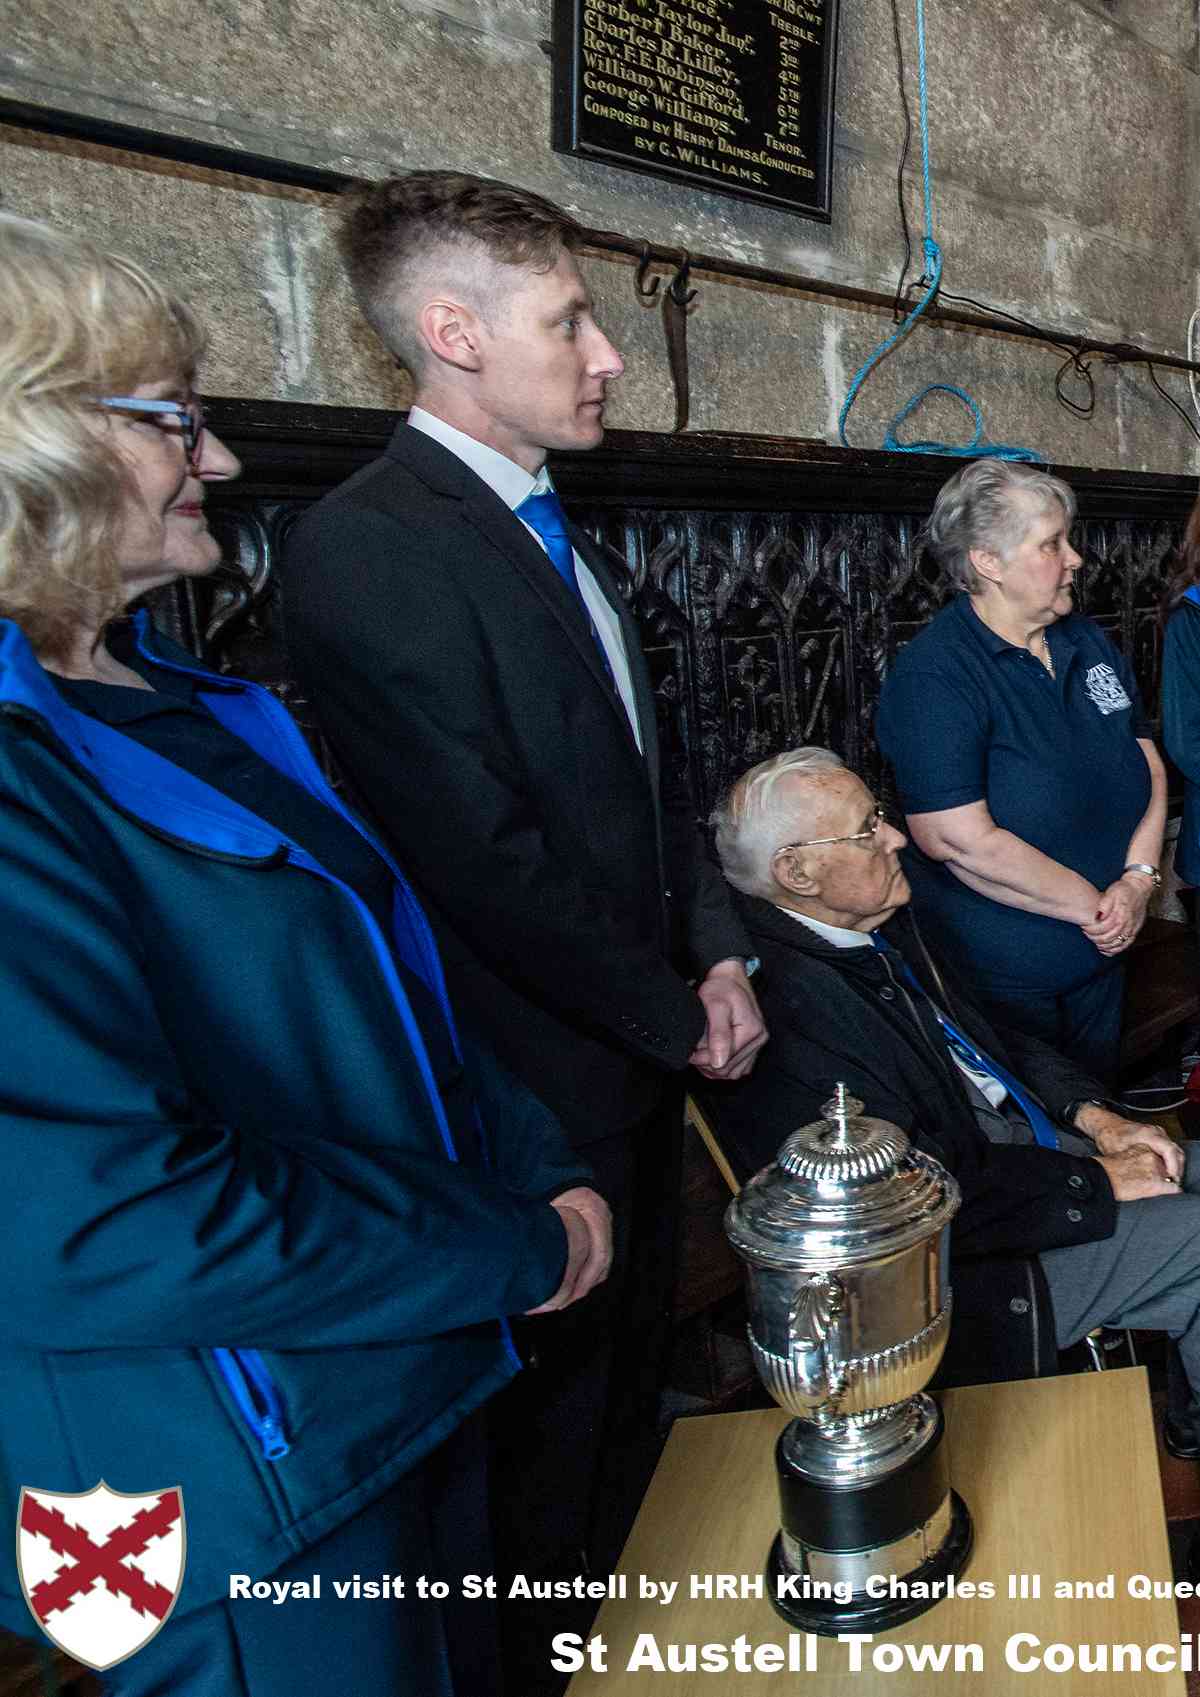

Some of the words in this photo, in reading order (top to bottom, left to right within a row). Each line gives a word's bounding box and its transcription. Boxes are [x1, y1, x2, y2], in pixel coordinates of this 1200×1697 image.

[584, 9, 658, 52] Charles
[660, 39, 680, 61] R.
[584, 49, 656, 93] William
[657, 75, 679, 98] W.
[584, 71, 652, 112] George
